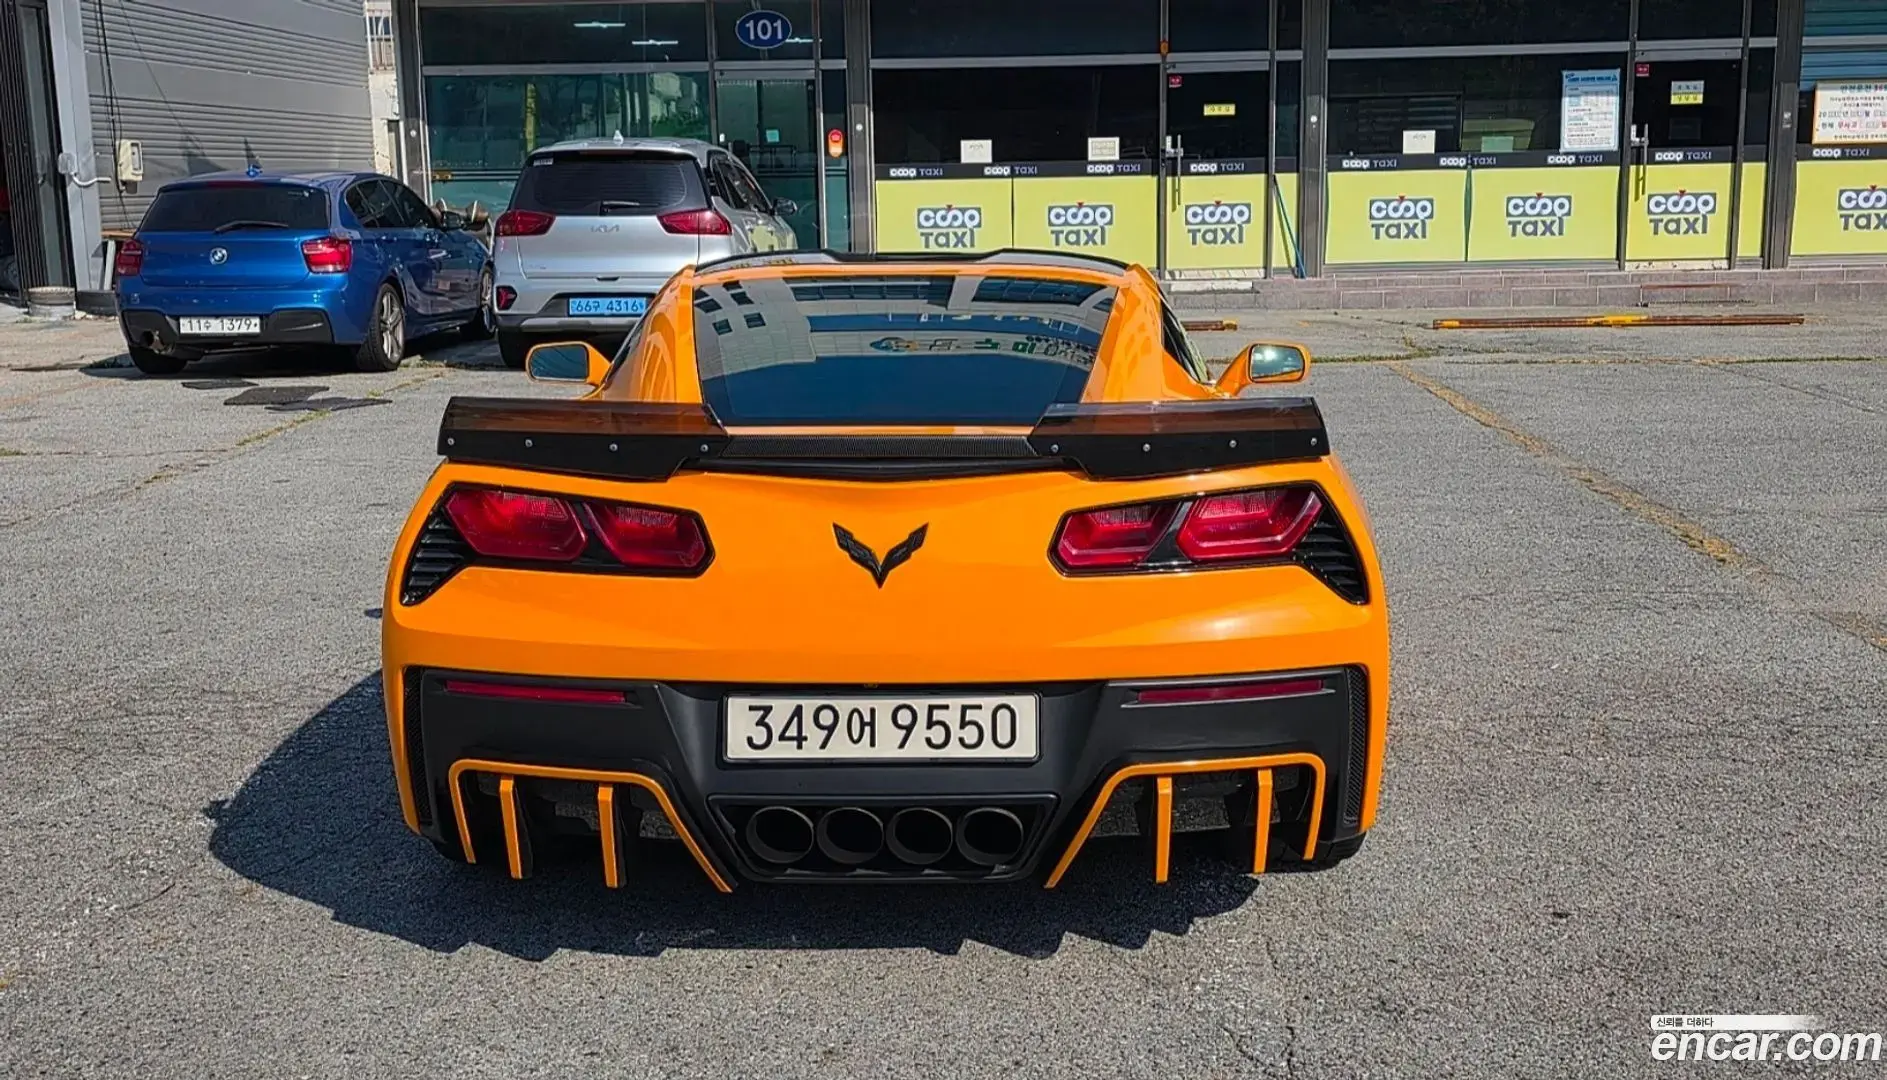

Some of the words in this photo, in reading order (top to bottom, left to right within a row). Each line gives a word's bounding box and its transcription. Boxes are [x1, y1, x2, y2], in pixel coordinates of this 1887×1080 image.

[745, 19, 783, 40] 101
[606, 300, 639, 312] 4316
[220, 318, 252, 332] 1379
[746, 703, 877, 751] 349어
[890, 703, 1017, 750] 9550
